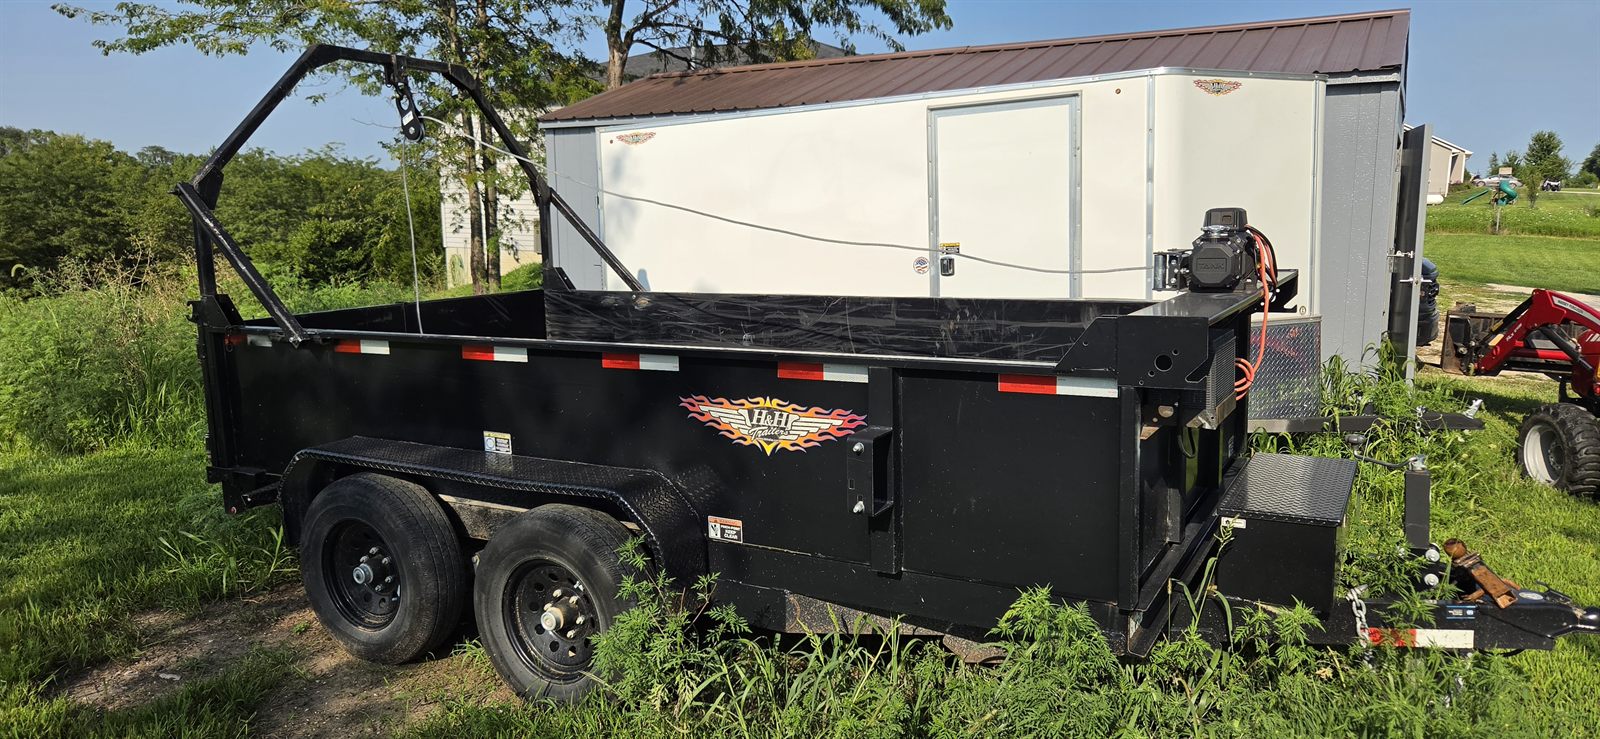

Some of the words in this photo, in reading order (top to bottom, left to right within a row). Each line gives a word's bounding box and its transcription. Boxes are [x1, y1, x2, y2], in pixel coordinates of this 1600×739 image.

[1198, 262, 1225, 270] TANK
[751, 408, 789, 427] H&H
[748, 427, 789, 440] Trailers
